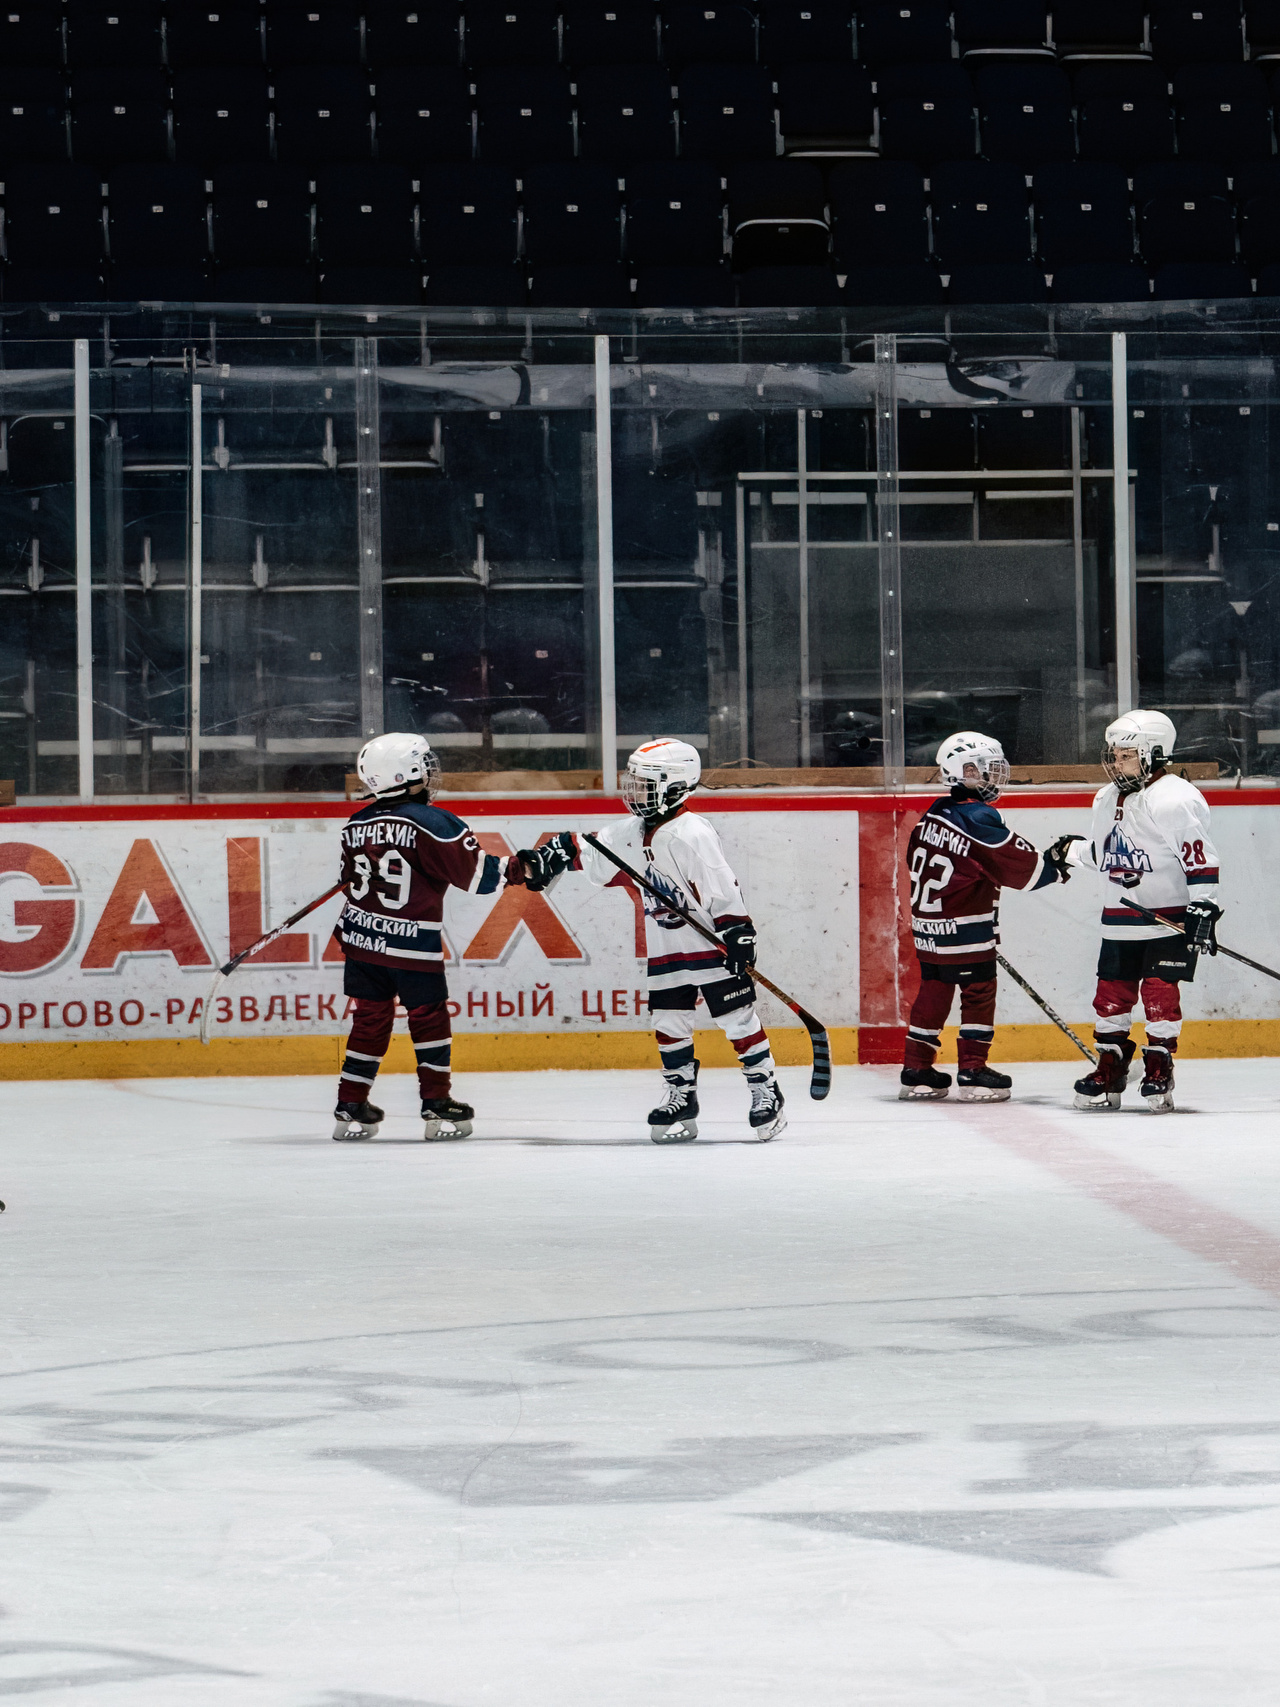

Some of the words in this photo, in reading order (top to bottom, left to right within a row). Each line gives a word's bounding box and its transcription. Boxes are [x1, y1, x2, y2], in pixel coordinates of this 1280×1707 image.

[1181, 839, 1207, 867] 28
[0, 832, 649, 976] GALX
[348, 930, 387, 953] КРАЙ
[582, 989, 655, 1023] ЦЕН
